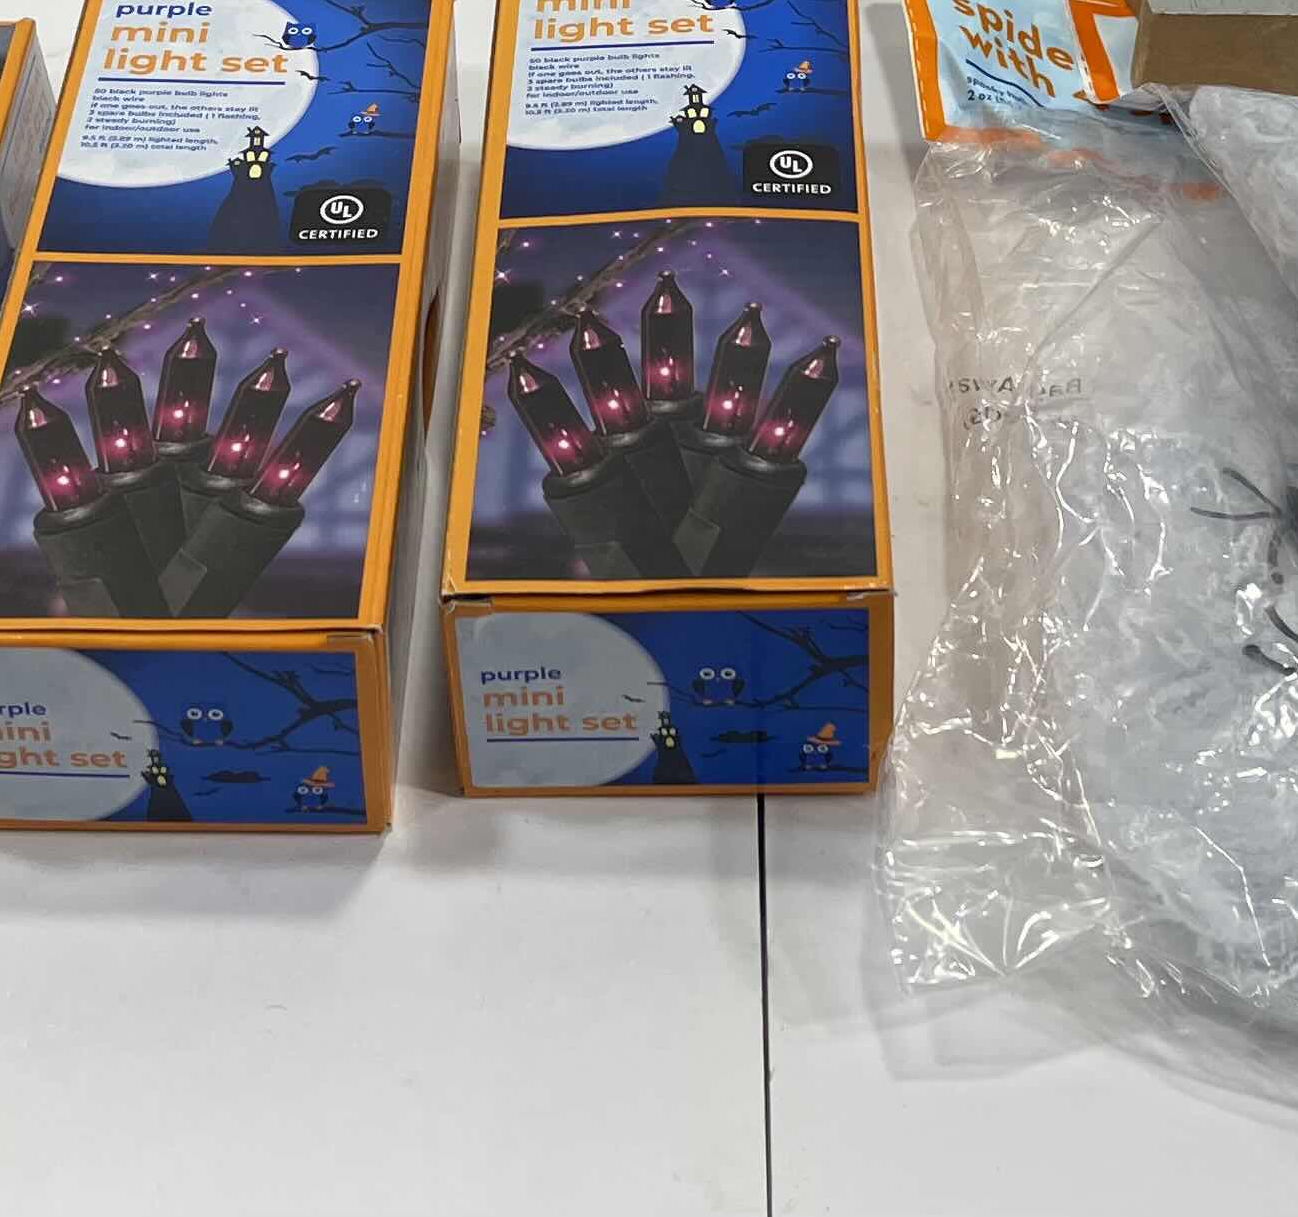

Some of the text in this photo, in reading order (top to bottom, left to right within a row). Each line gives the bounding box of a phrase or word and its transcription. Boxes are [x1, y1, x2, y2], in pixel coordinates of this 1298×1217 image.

[115, 1, 212, 19] purple
[111, 21, 210, 43] mini
[533, 14, 714, 43] light set
[103, 48, 288, 74] light set
[959, 25, 1055, 98] with
[967, 90, 975, 101] 2
[778, 155, 802, 174] UL
[752, 182, 832, 195] CERTIFIED
[330, 201, 353, 218] UL
[298, 228, 378, 240] CERTIFIED
[480, 666, 561, 684] purple
[483, 686, 565, 707] mini
[485, 710, 637, 735] light set
[70, 749, 127, 769] set
